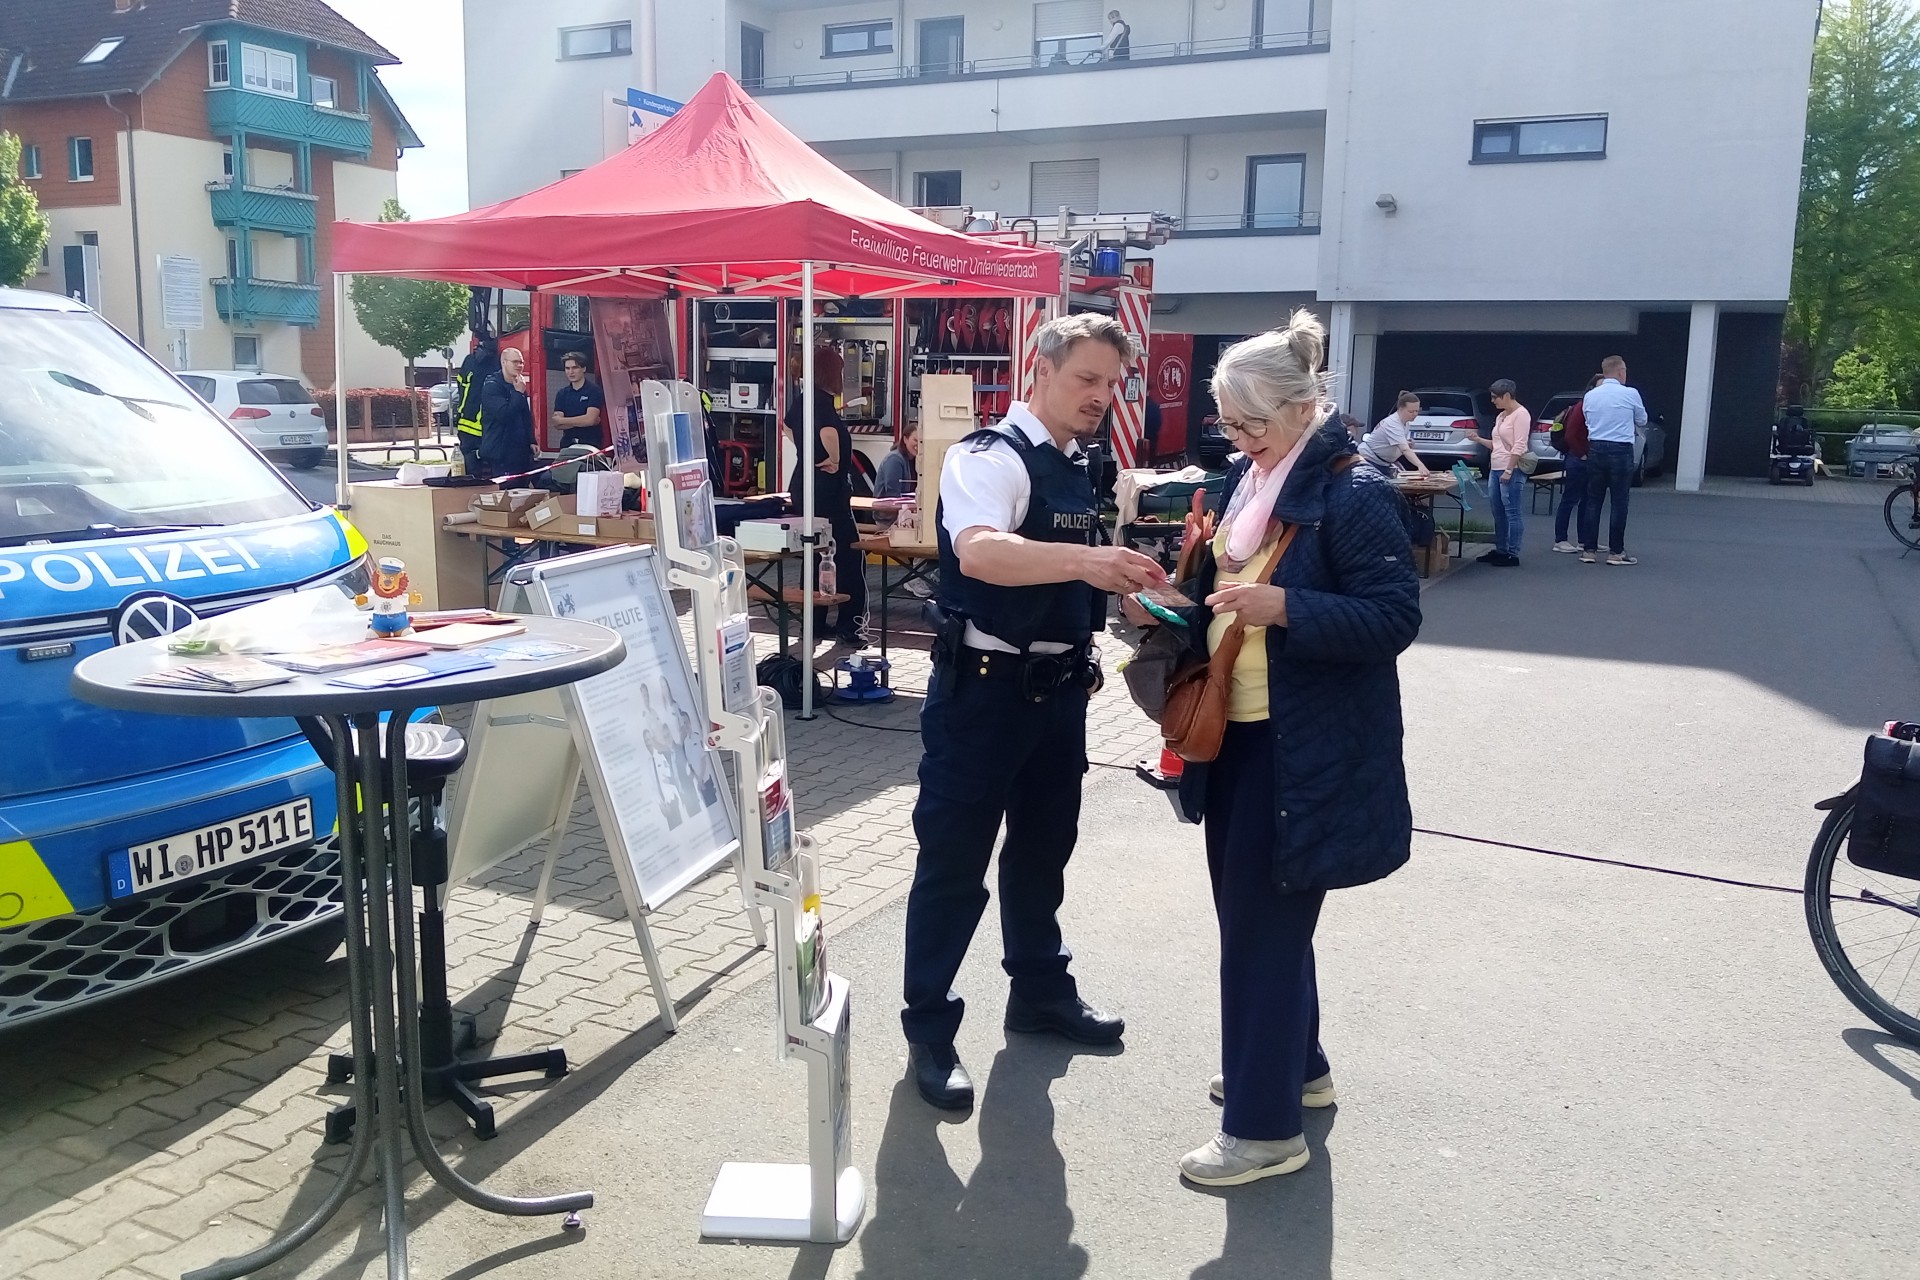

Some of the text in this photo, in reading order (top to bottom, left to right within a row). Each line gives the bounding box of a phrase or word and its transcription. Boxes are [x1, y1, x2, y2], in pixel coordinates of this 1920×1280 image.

[850, 228, 1038, 279] Freiwillige Feuerwehr Unterliederbach
[1053, 512, 1091, 530] POLIZEI
[117, 879, 126, 890] D
